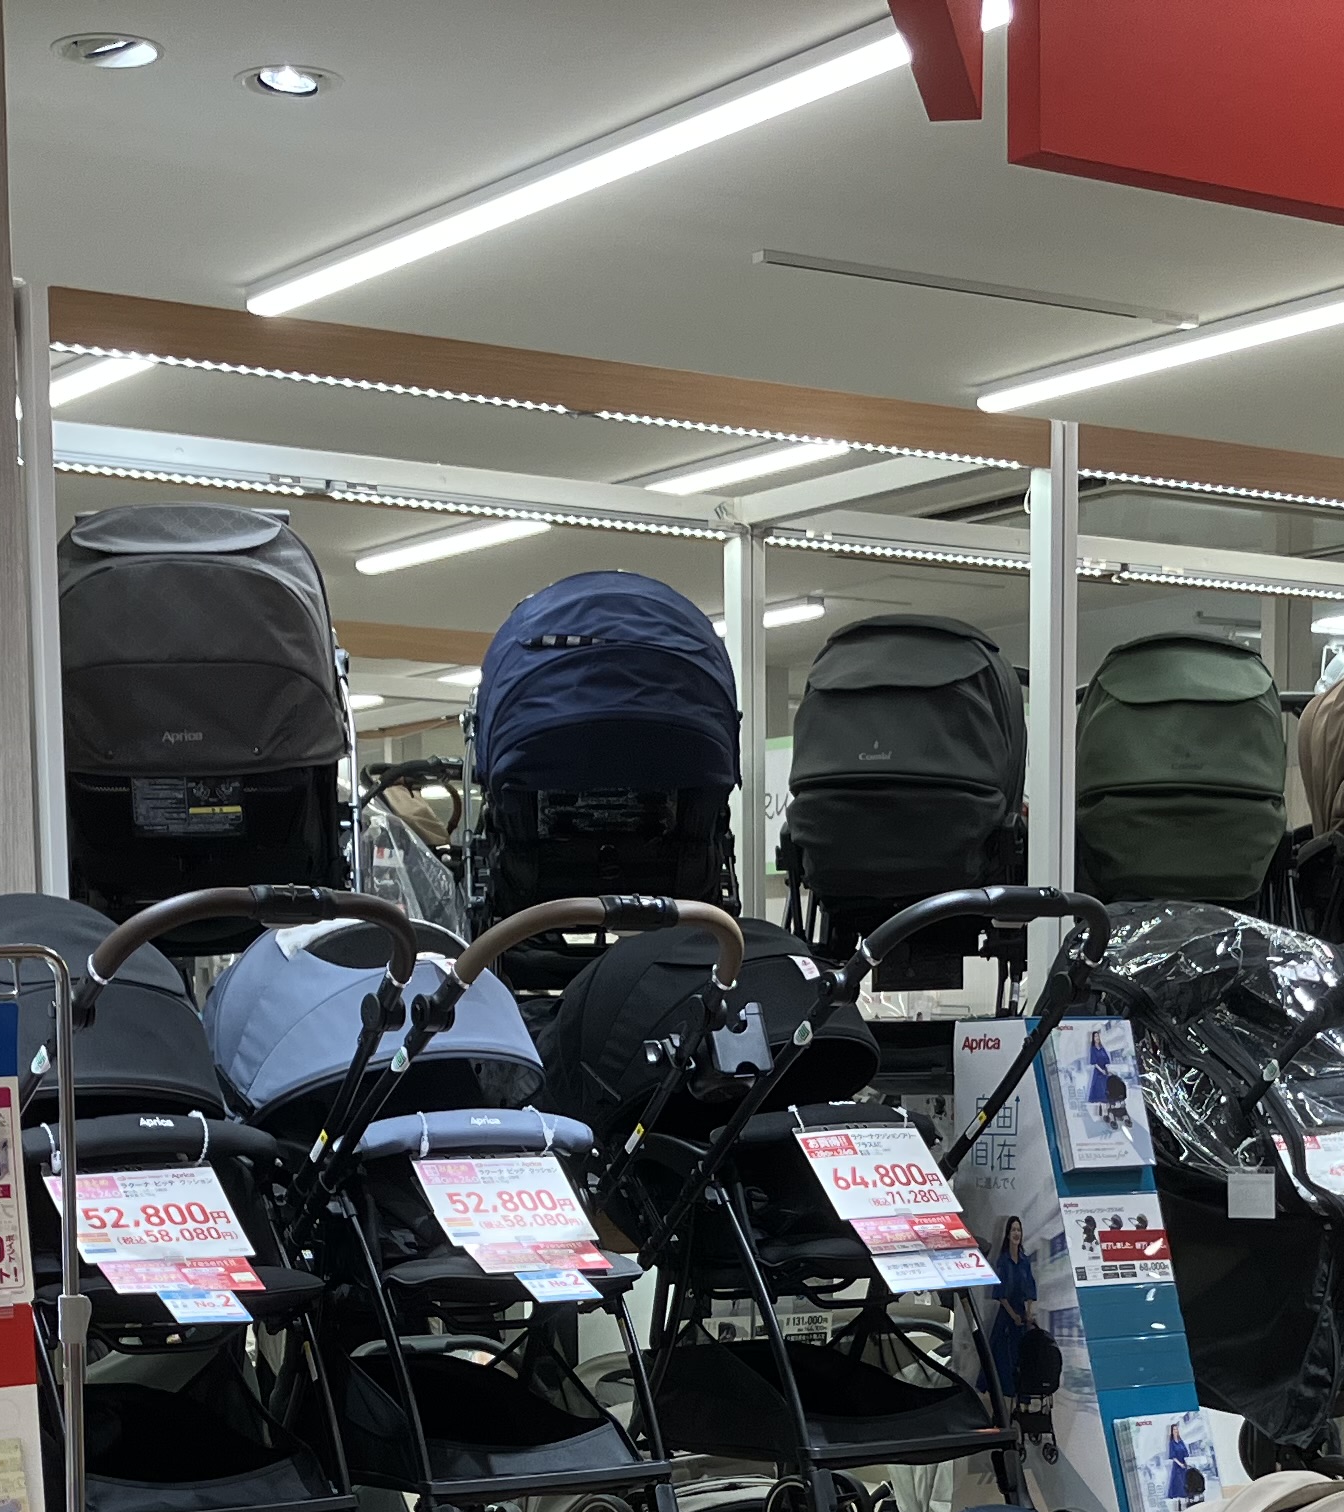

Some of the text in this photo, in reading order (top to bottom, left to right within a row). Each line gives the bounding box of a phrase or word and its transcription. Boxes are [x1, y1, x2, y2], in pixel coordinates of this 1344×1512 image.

[162, 728, 204, 745] Aprica
[961, 1033, 1002, 1054] Aprica
[139, 1116, 175, 1129] Aprica
[470, 1116, 502, 1127] Aprica
[832, 1162, 944, 1192] 64,800円
[445, 1189, 577, 1216] 52,800円
[81, 1202, 232, 1231] 52,800円
